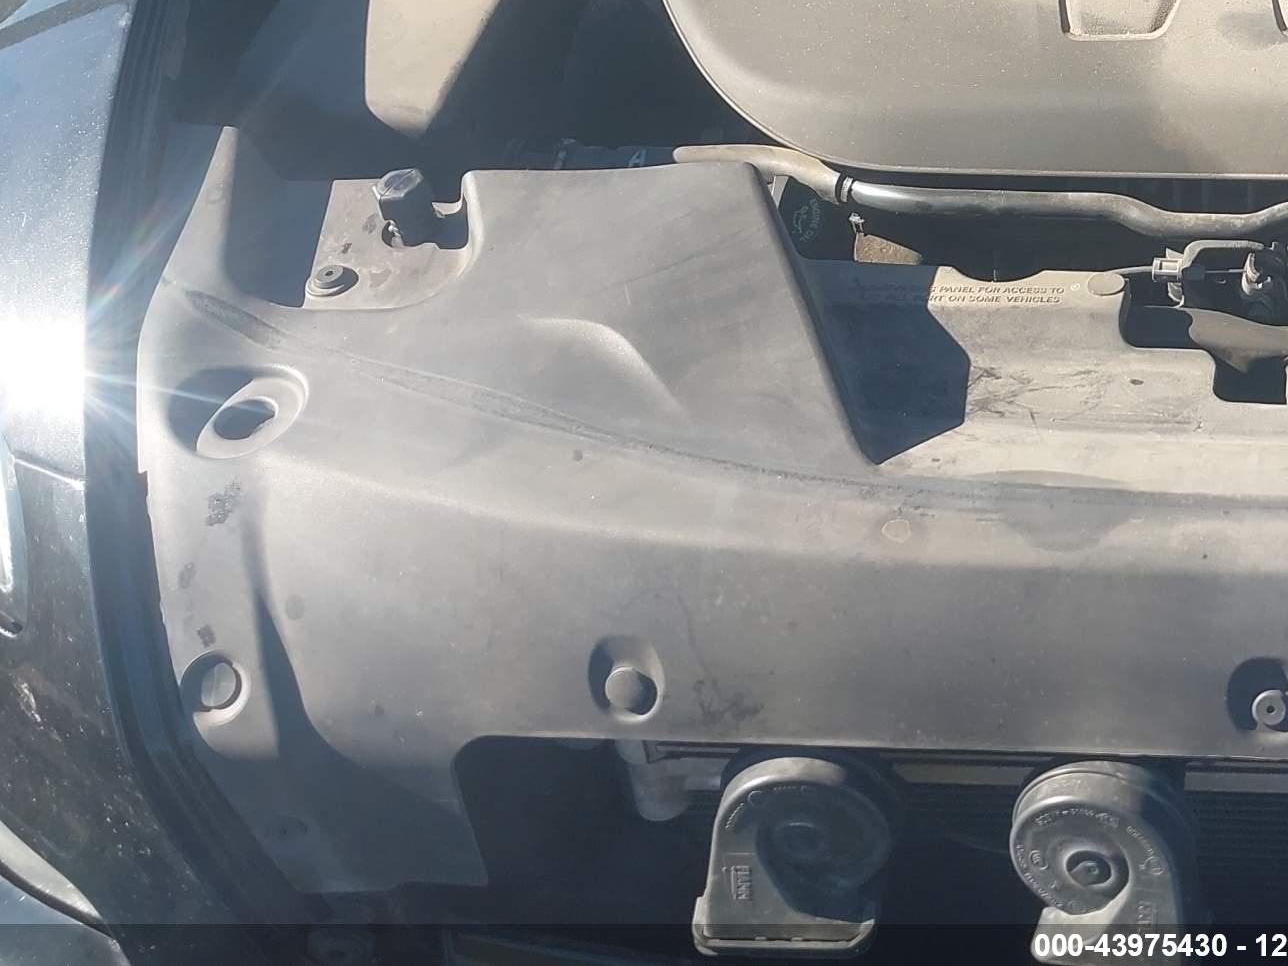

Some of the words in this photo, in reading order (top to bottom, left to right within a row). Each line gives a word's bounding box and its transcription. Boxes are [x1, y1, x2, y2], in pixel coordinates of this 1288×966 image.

[977, 286, 1000, 294] FOR
[1002, 286, 1048, 295] ACCESS
[1050, 287, 1065, 295] TO
[948, 295, 966, 303] ON
[967, 295, 1001, 303] SOME
[1006, 296, 1061, 304] VEHICLES
